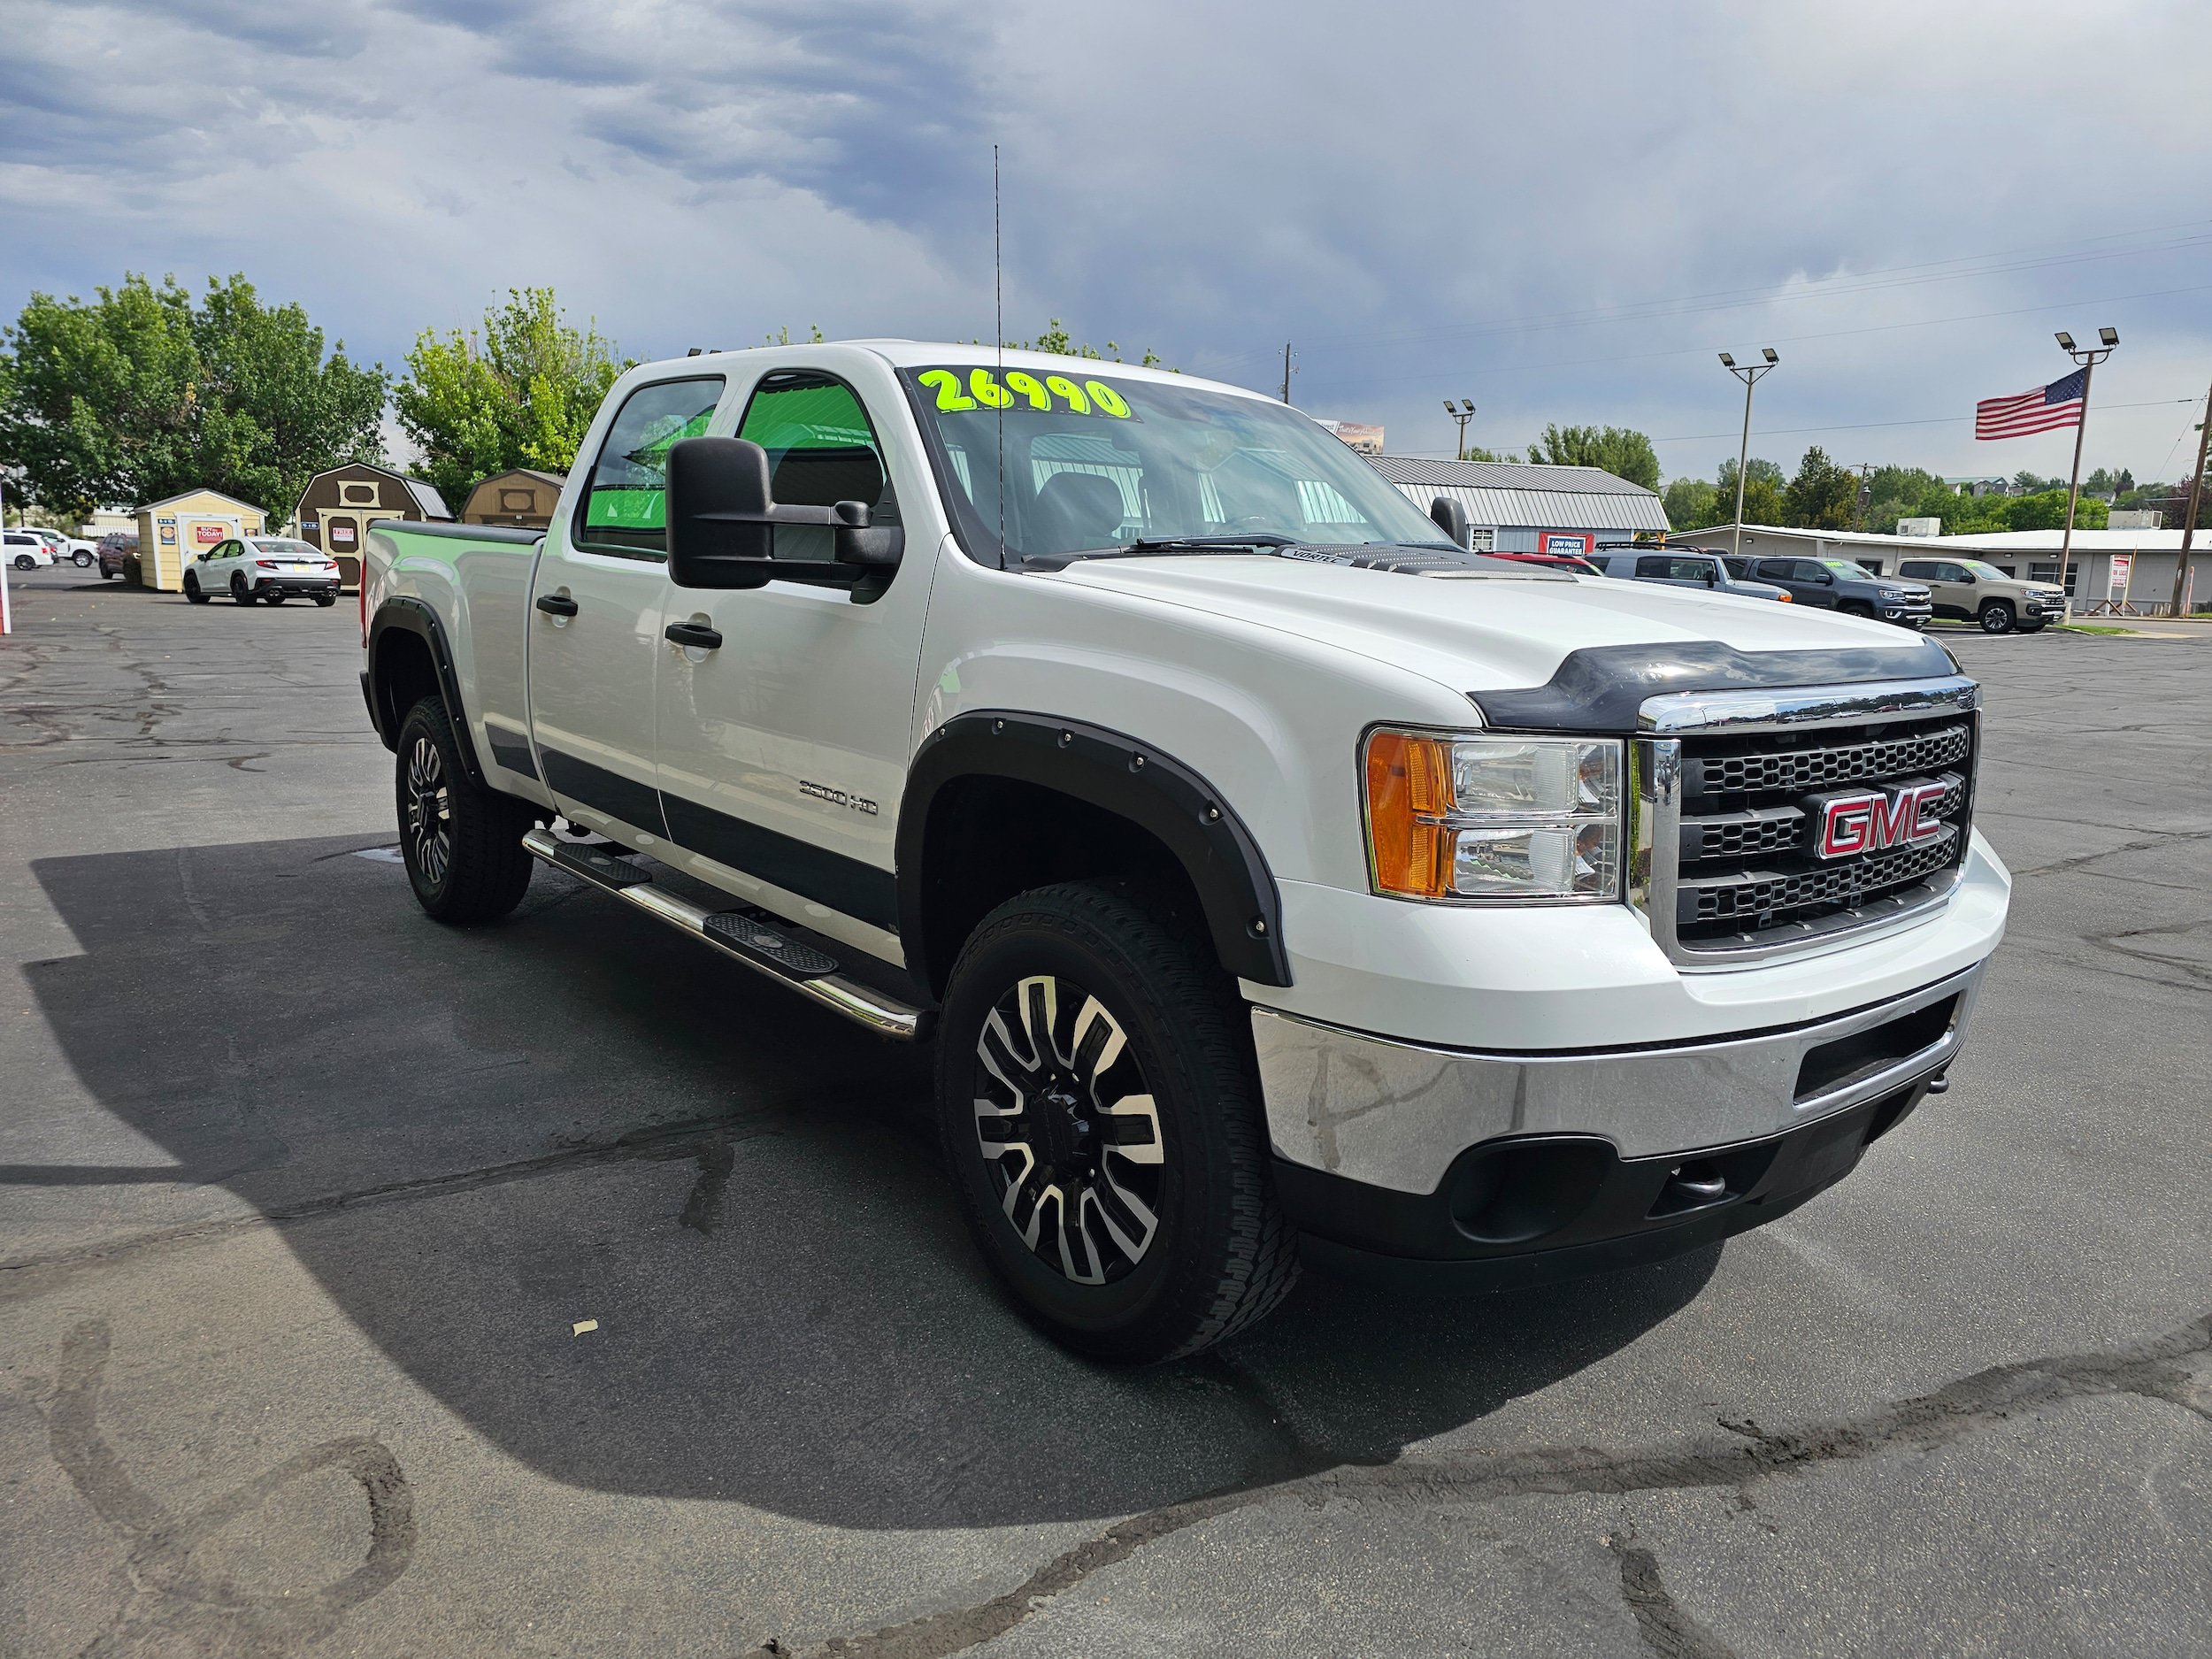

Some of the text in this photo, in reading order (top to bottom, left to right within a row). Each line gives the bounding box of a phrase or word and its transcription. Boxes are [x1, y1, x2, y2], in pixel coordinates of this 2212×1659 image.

[918, 368, 1132, 419] 26990
[1293, 550, 1344, 563] VORTEC
[799, 780, 878, 816] 2500 HD
[1816, 781, 1947, 860] GMC
